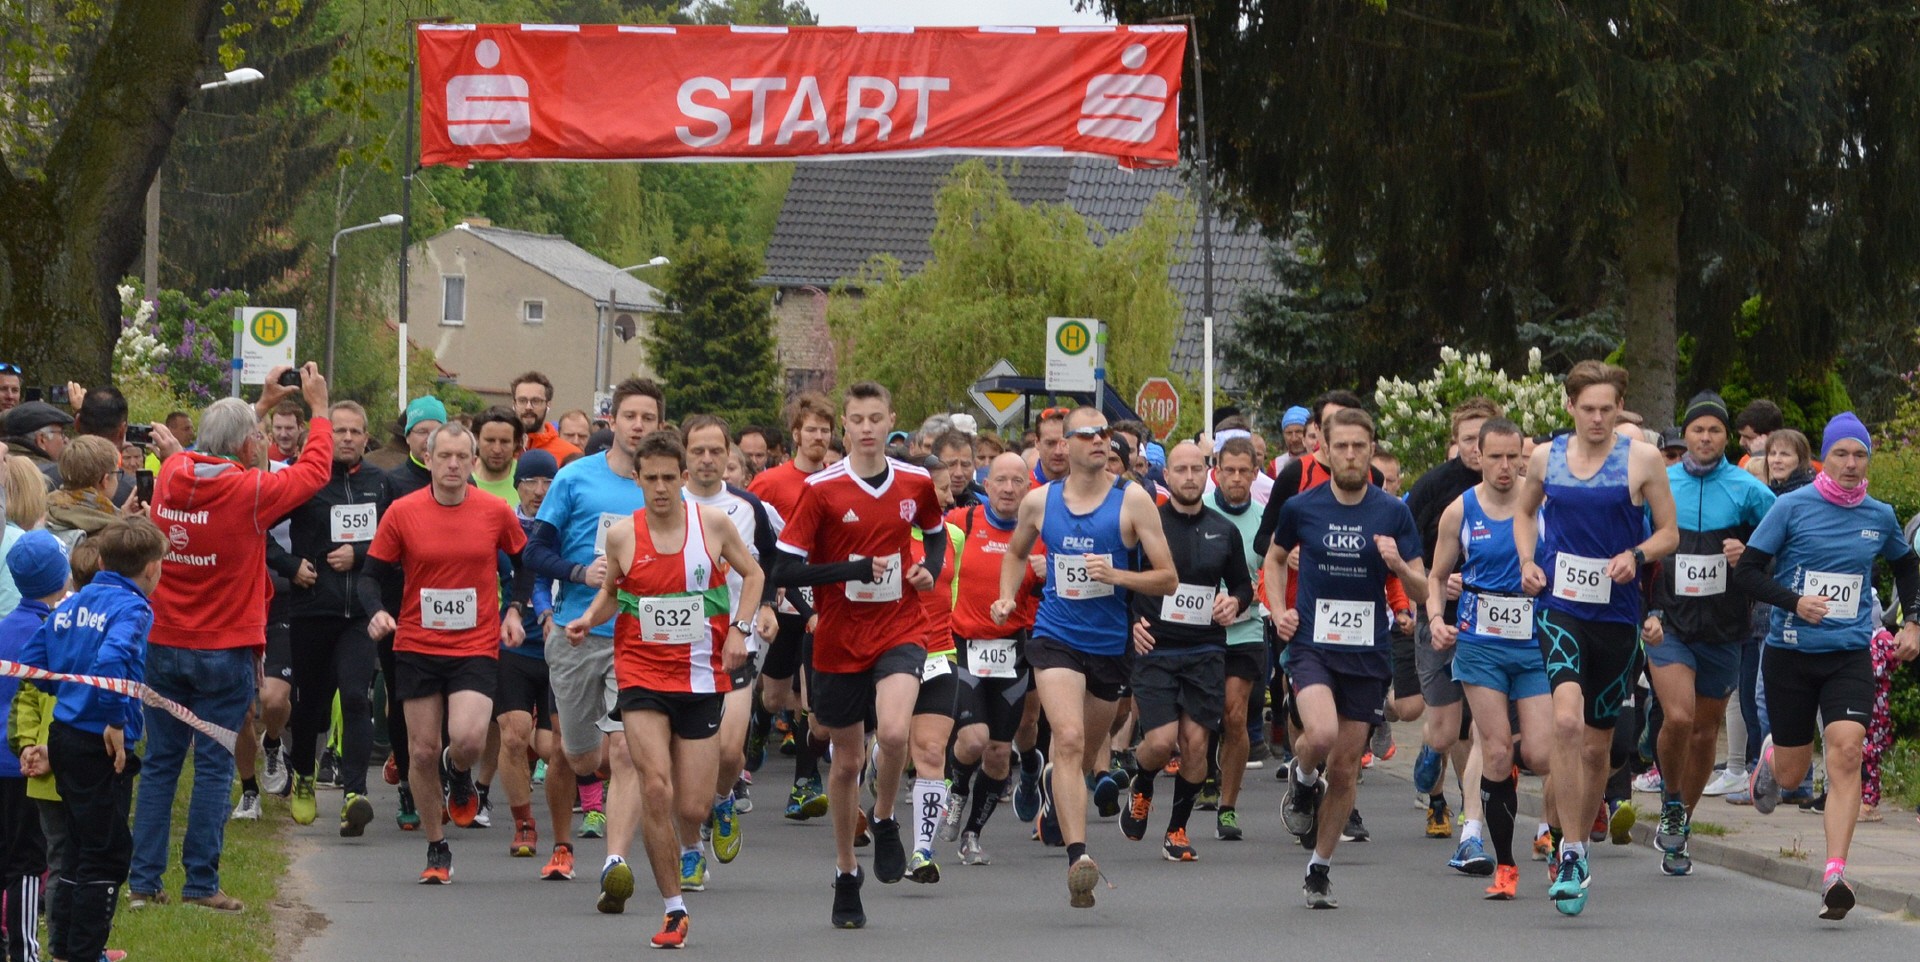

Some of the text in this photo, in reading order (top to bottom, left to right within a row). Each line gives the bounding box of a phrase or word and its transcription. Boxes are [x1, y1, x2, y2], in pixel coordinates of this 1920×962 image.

[675, 76, 950, 148] START
[262, 317, 276, 338] H
[1066, 328, 1080, 348] H
[1141, 398, 1174, 421] STOP
[342, 513, 369, 529] 559
[1329, 535, 1360, 549] LKK
[1066, 567, 1098, 583] 53
[1566, 566, 1600, 587] 556
[1687, 565, 1717, 580] 644
[1175, 594, 1205, 610] 660
[1817, 584, 1851, 602] 420
[433, 600, 465, 615] 648
[1489, 606, 1522, 624] 643
[654, 608, 692, 627] 632
[1329, 611, 1363, 628] 425
[979, 648, 1007, 664] 405
[919, 791, 944, 842] eleven
